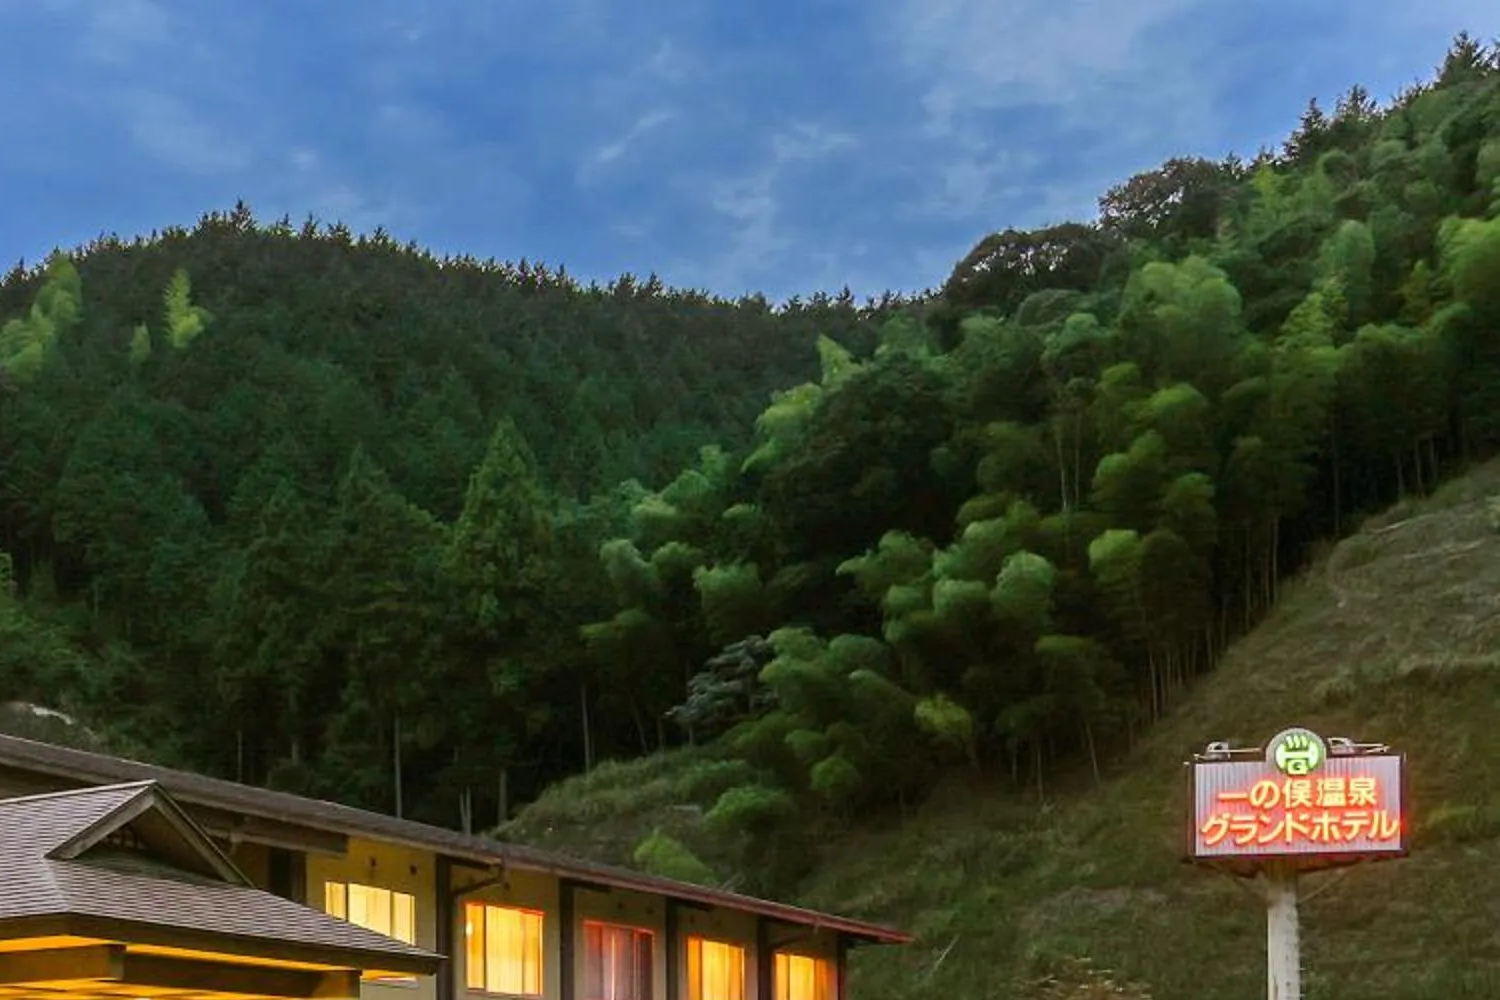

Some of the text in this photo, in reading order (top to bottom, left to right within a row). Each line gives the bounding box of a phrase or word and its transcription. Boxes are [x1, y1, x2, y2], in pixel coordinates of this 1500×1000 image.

[1218, 777, 1378, 809] 一の俣温泉
[1201, 809, 1399, 845] グランドホテル
